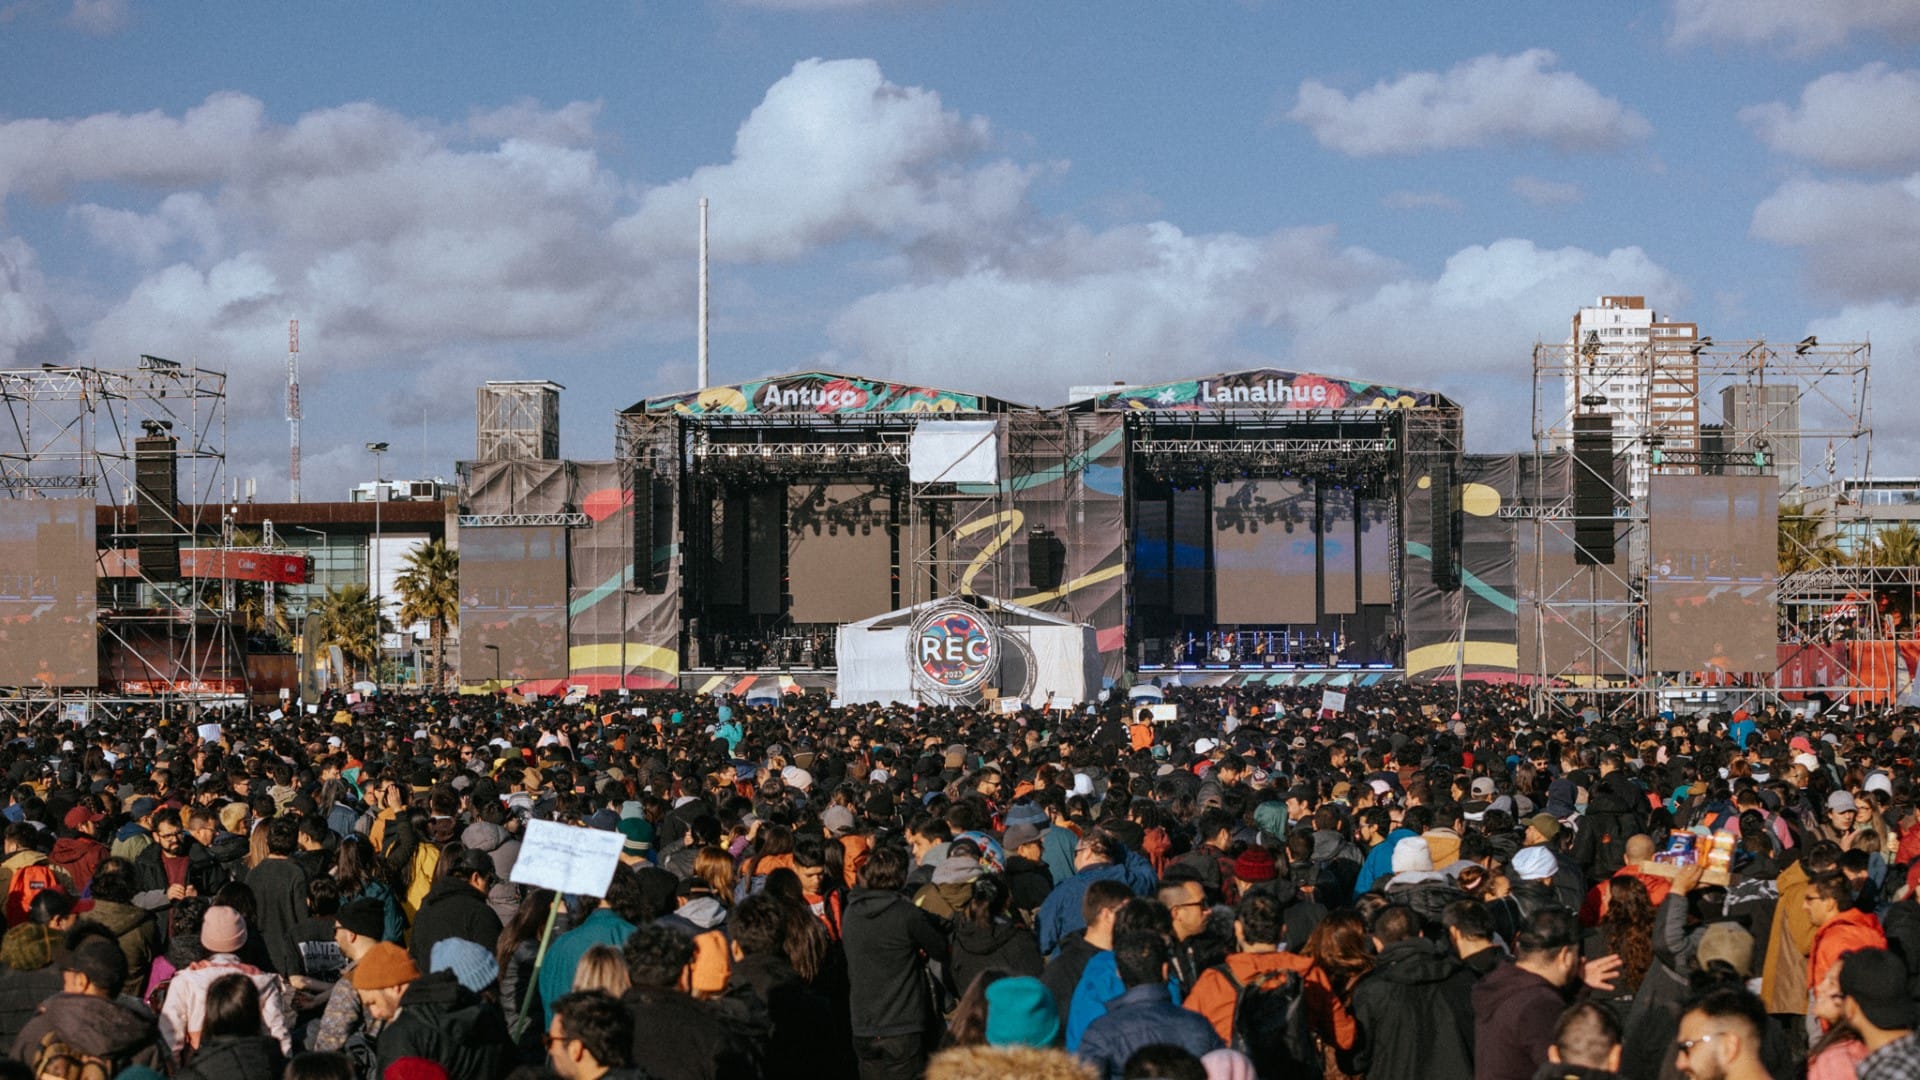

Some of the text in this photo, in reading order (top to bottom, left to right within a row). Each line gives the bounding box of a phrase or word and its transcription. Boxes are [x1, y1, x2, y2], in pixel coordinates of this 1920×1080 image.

[763, 385, 857, 406] Antuco
[1202, 380, 1326, 402] Lanalhue
[922, 636, 988, 662] REC
